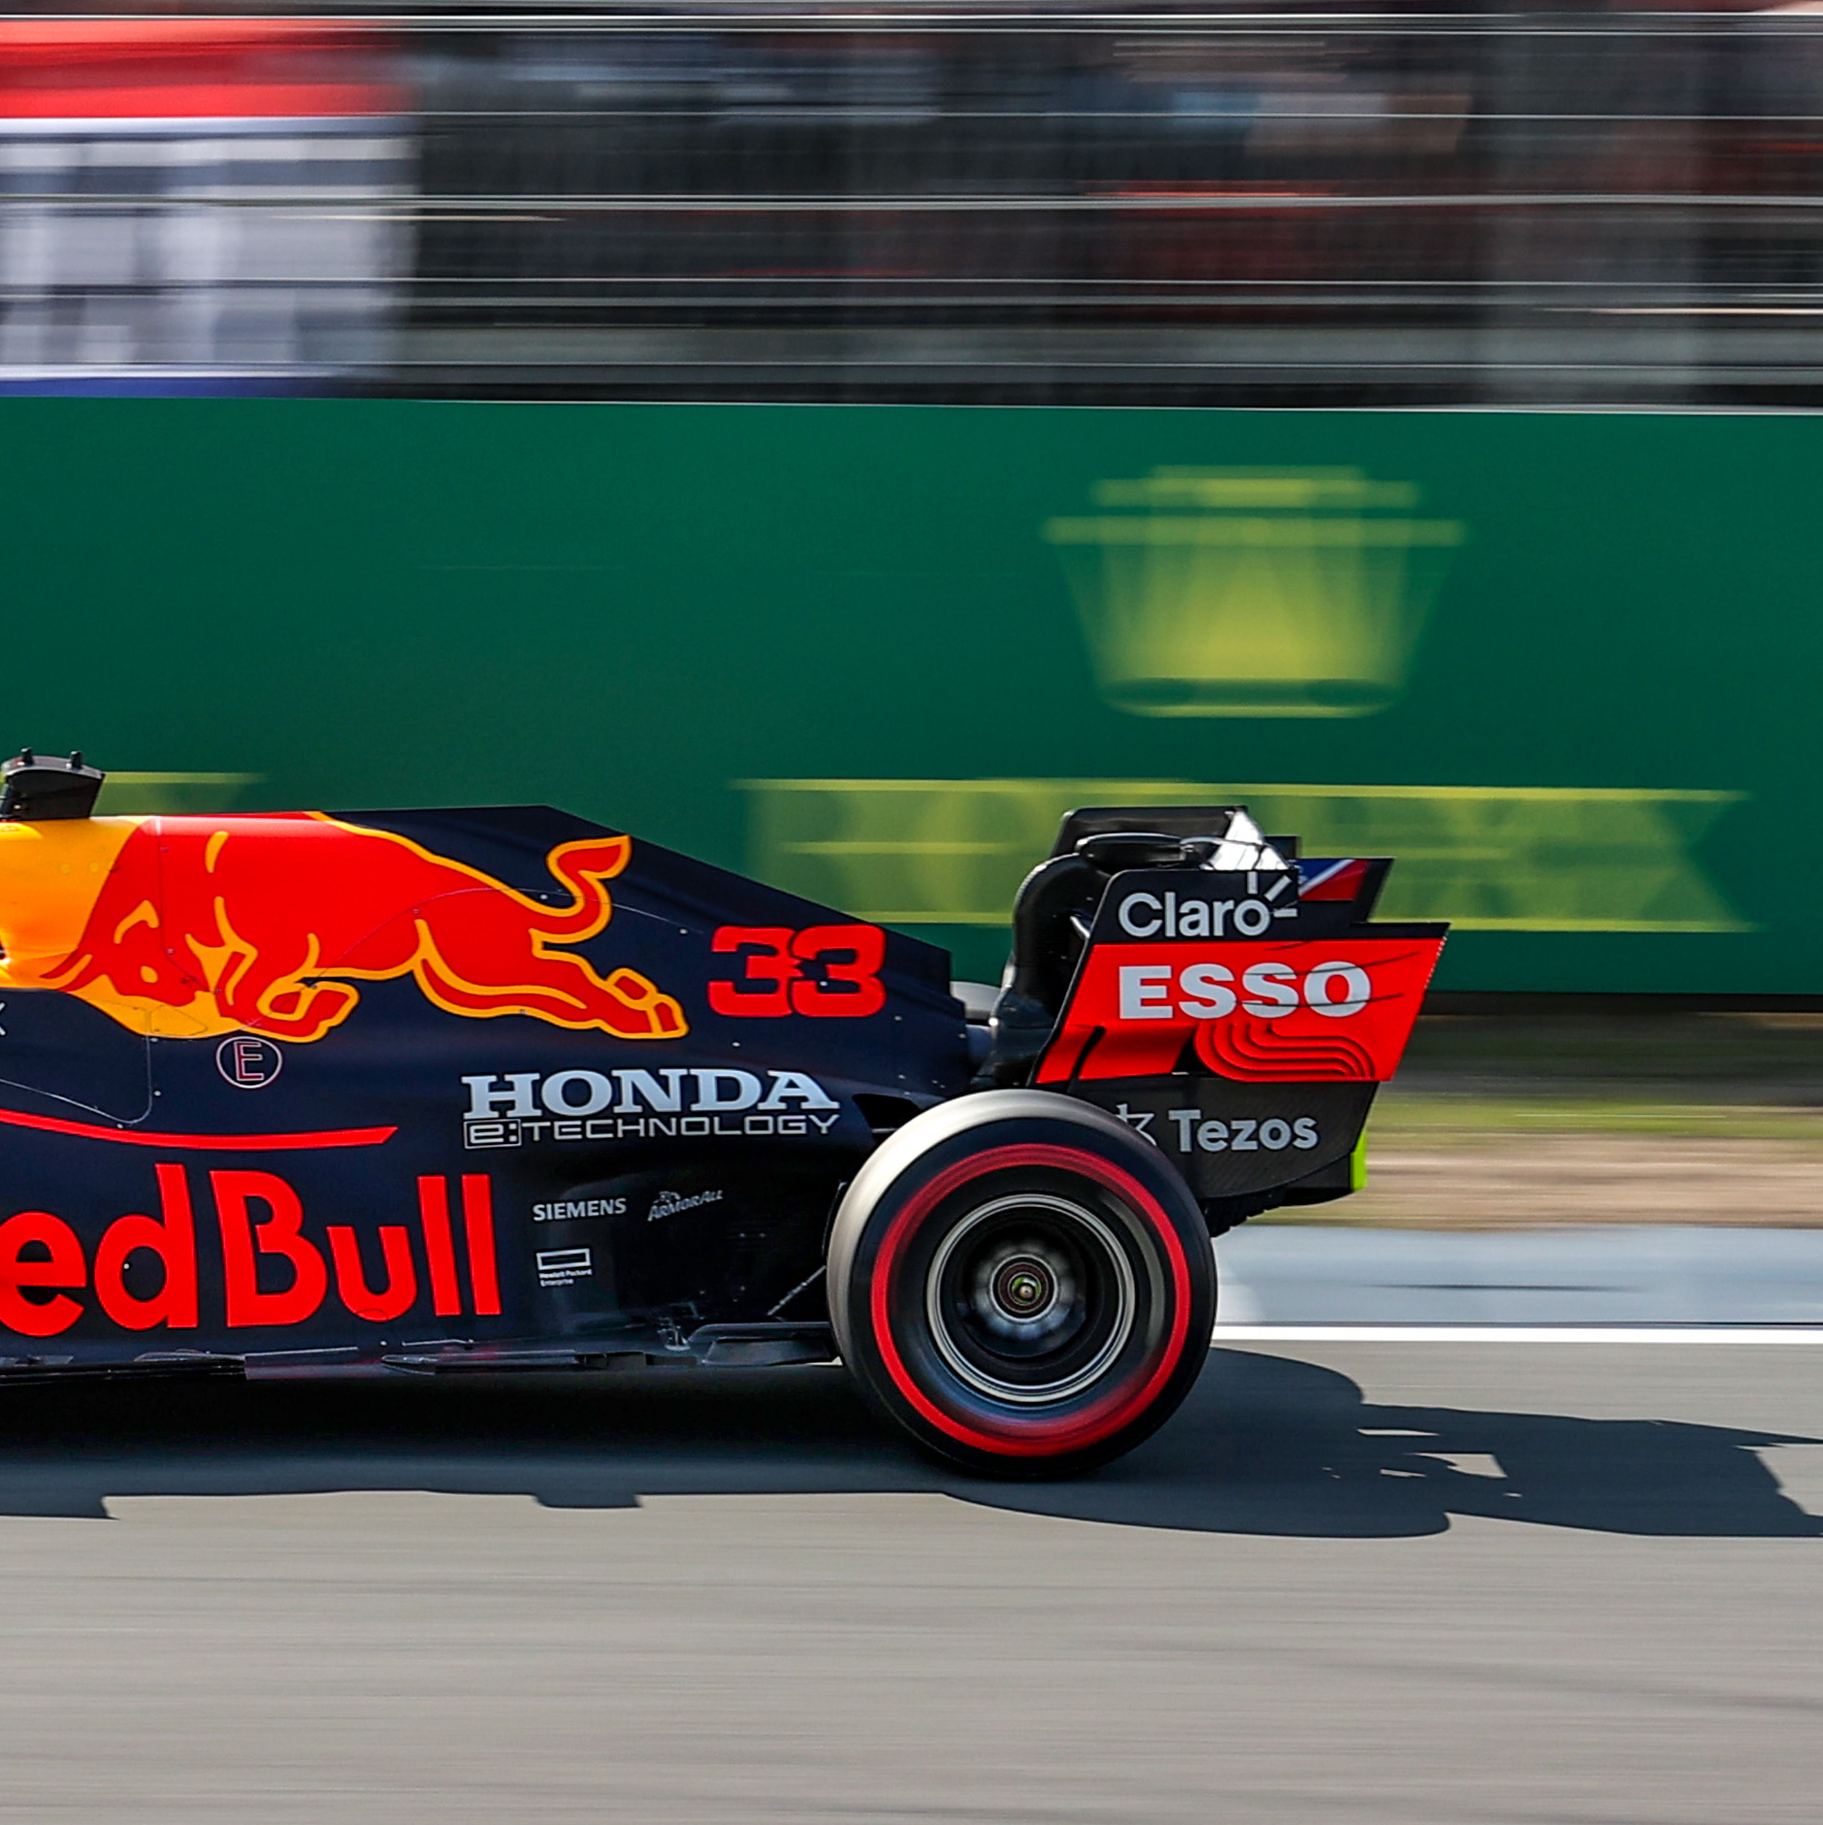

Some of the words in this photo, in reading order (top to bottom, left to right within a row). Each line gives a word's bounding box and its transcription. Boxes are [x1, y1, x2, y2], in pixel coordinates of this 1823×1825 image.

[1119, 891, 1271, 938] Claro
[708, 925, 886, 1018] 33
[1118, 960, 1372, 1020] ESSO
[231, 1040, 265, 1082] E
[461, 1068, 841, 1120] HONDA
[1168, 1109, 1320, 1153] Tezos
[532, 1197, 627, 1222] SIEMENS
